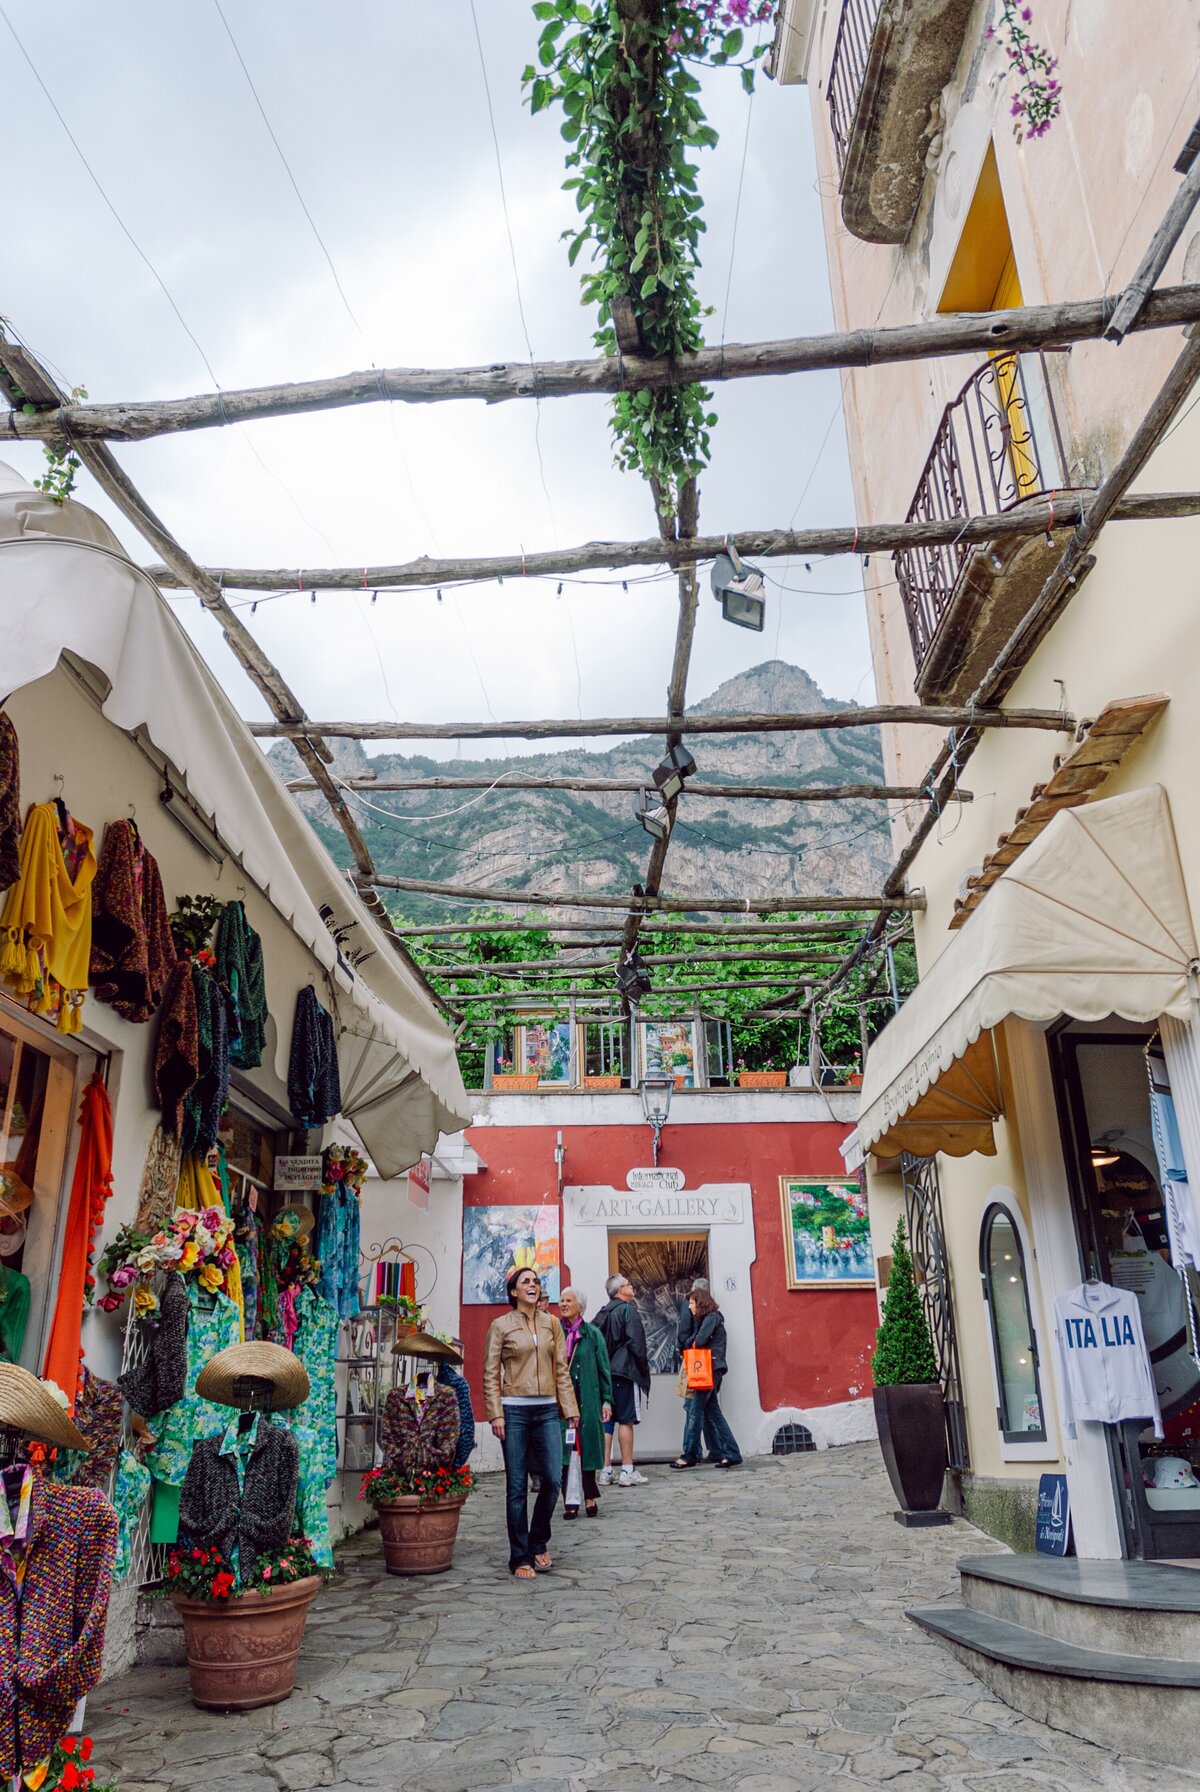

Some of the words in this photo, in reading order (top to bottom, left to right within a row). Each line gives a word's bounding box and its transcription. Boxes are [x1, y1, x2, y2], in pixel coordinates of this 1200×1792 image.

[884, 1075, 912, 1115] Boutique
[632, 1171, 678, 1181] International
[659, 1180, 679, 1191] Club
[595, 1199, 632, 1217] ART
[638, 1197, 720, 1217] GALLERY
[1065, 1315, 1135, 1348] ITALIA
